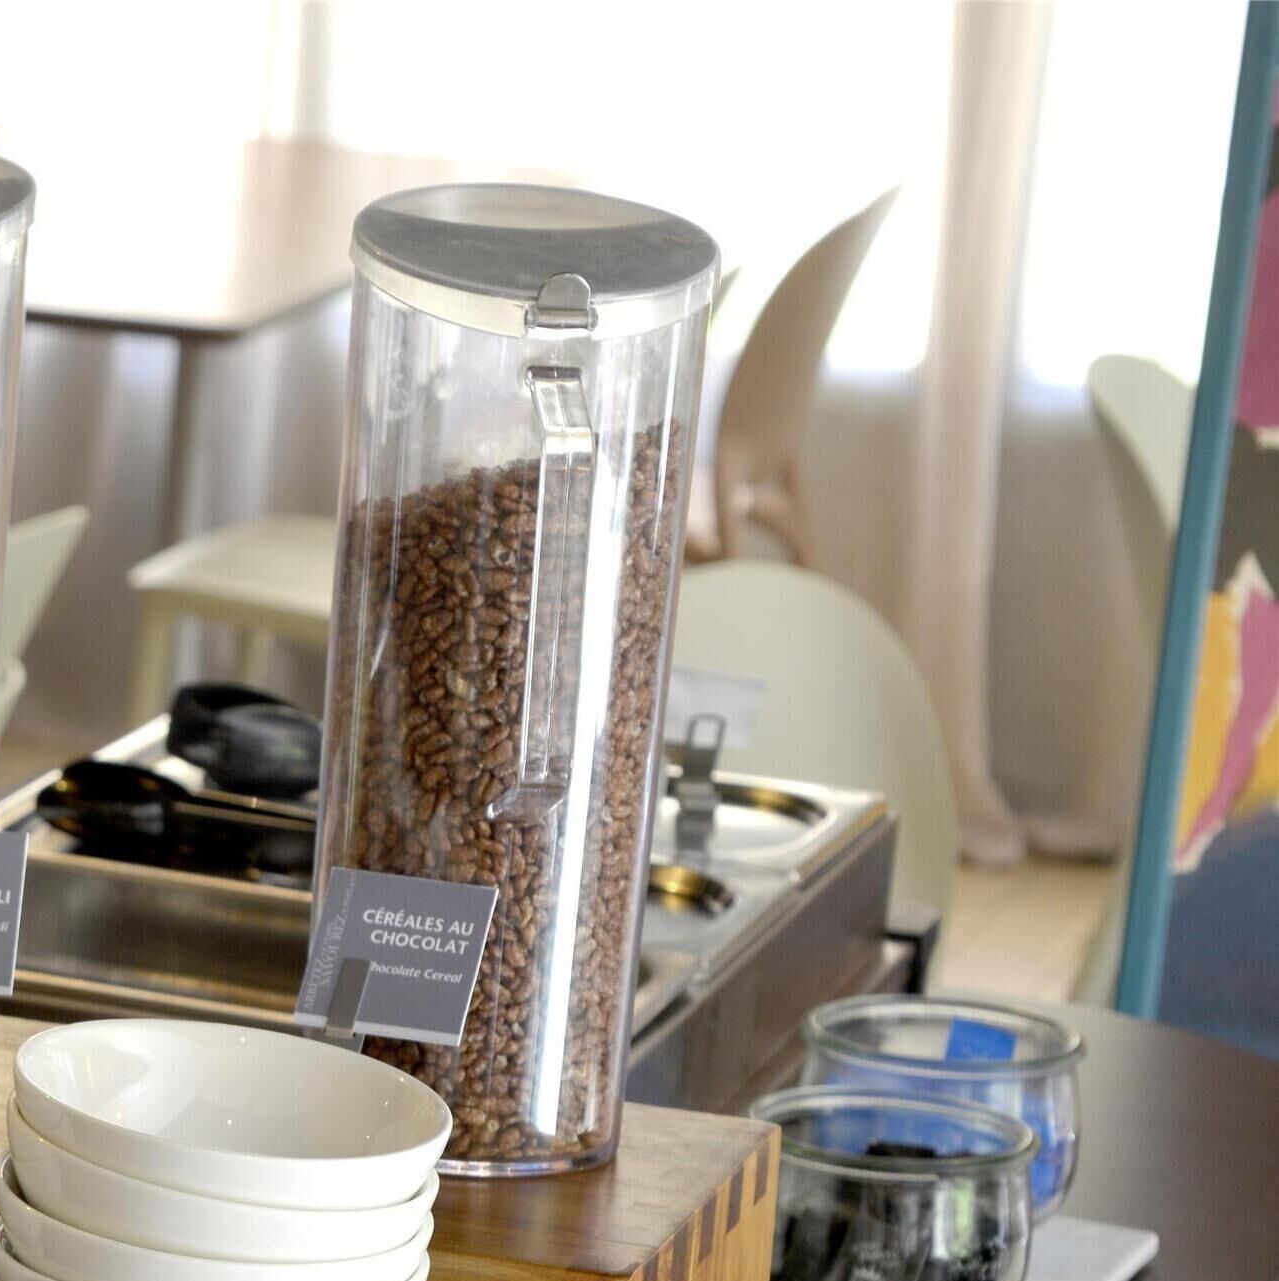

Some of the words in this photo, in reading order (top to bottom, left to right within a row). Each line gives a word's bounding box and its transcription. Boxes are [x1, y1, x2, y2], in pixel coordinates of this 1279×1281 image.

[363, 908, 443, 932] CÉRÉALES
[448, 921, 474, 936] AU
[371, 930, 468, 955] CHOCOLAT
[371, 961, 421, 977] hocolate
[424, 969, 463, 983] Cereal
